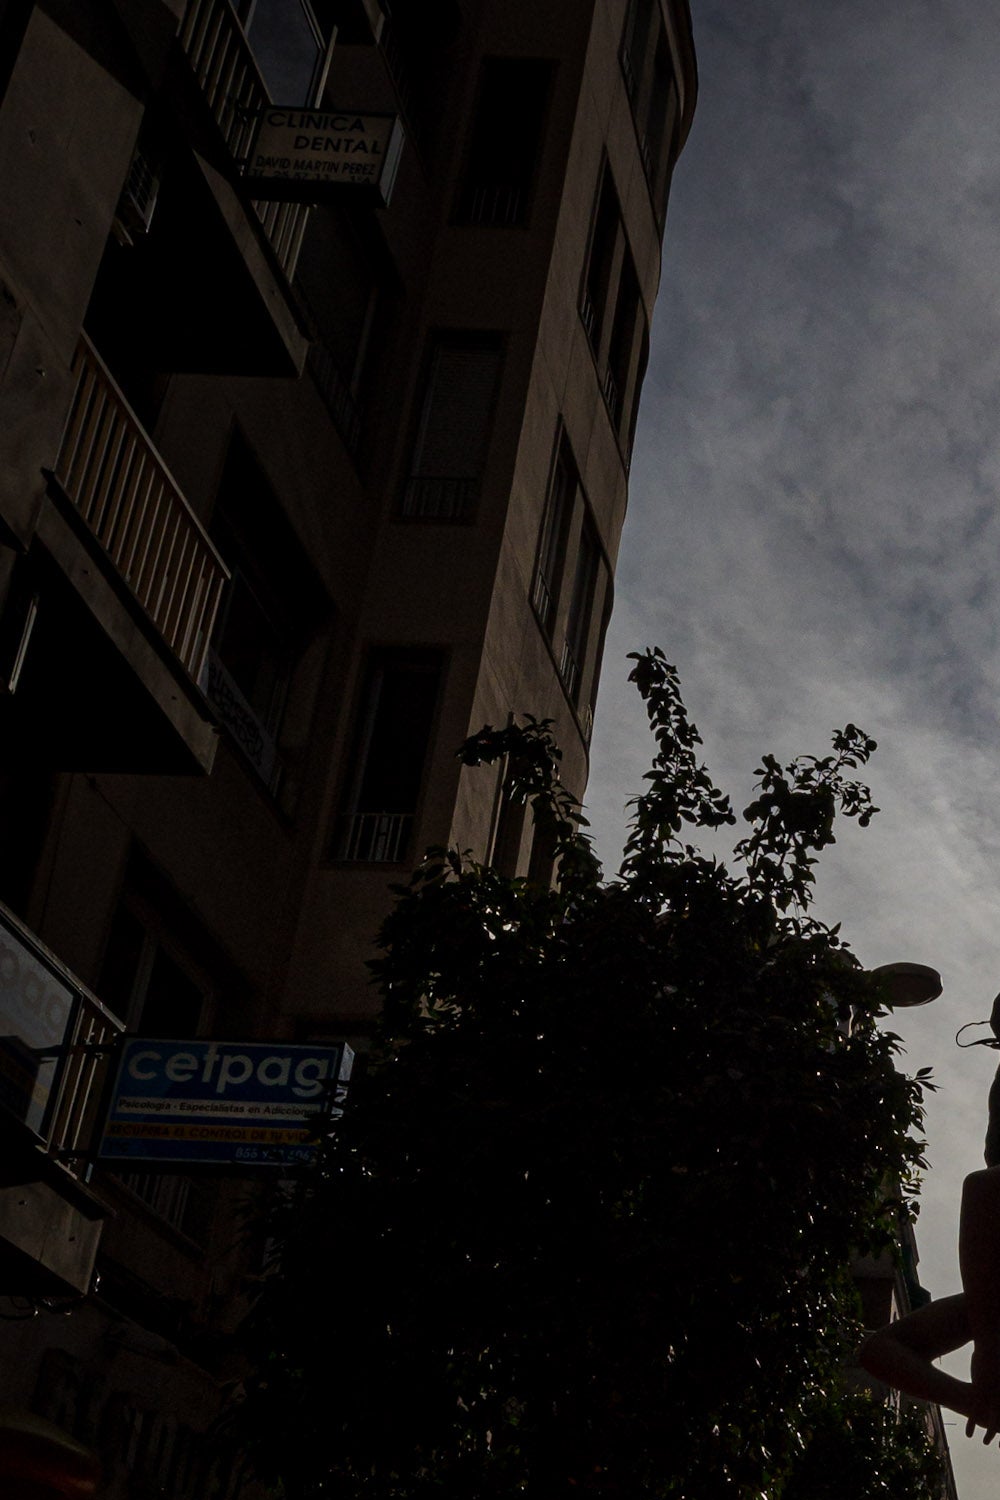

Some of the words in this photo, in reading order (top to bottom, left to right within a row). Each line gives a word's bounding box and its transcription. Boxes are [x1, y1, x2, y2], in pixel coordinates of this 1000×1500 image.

[294, 136, 381, 154] DENTAL
[256, 155, 291, 168] DAVID
[128, 1041, 329, 1098] cetpag
[179, 1101, 245, 1114] Especialistas
[247, 1105, 261, 1114] en
[189, 1127, 247, 1139] CONTROL
[250, 1129, 266, 1140] DE
[286, 1131, 312, 1143] VID
